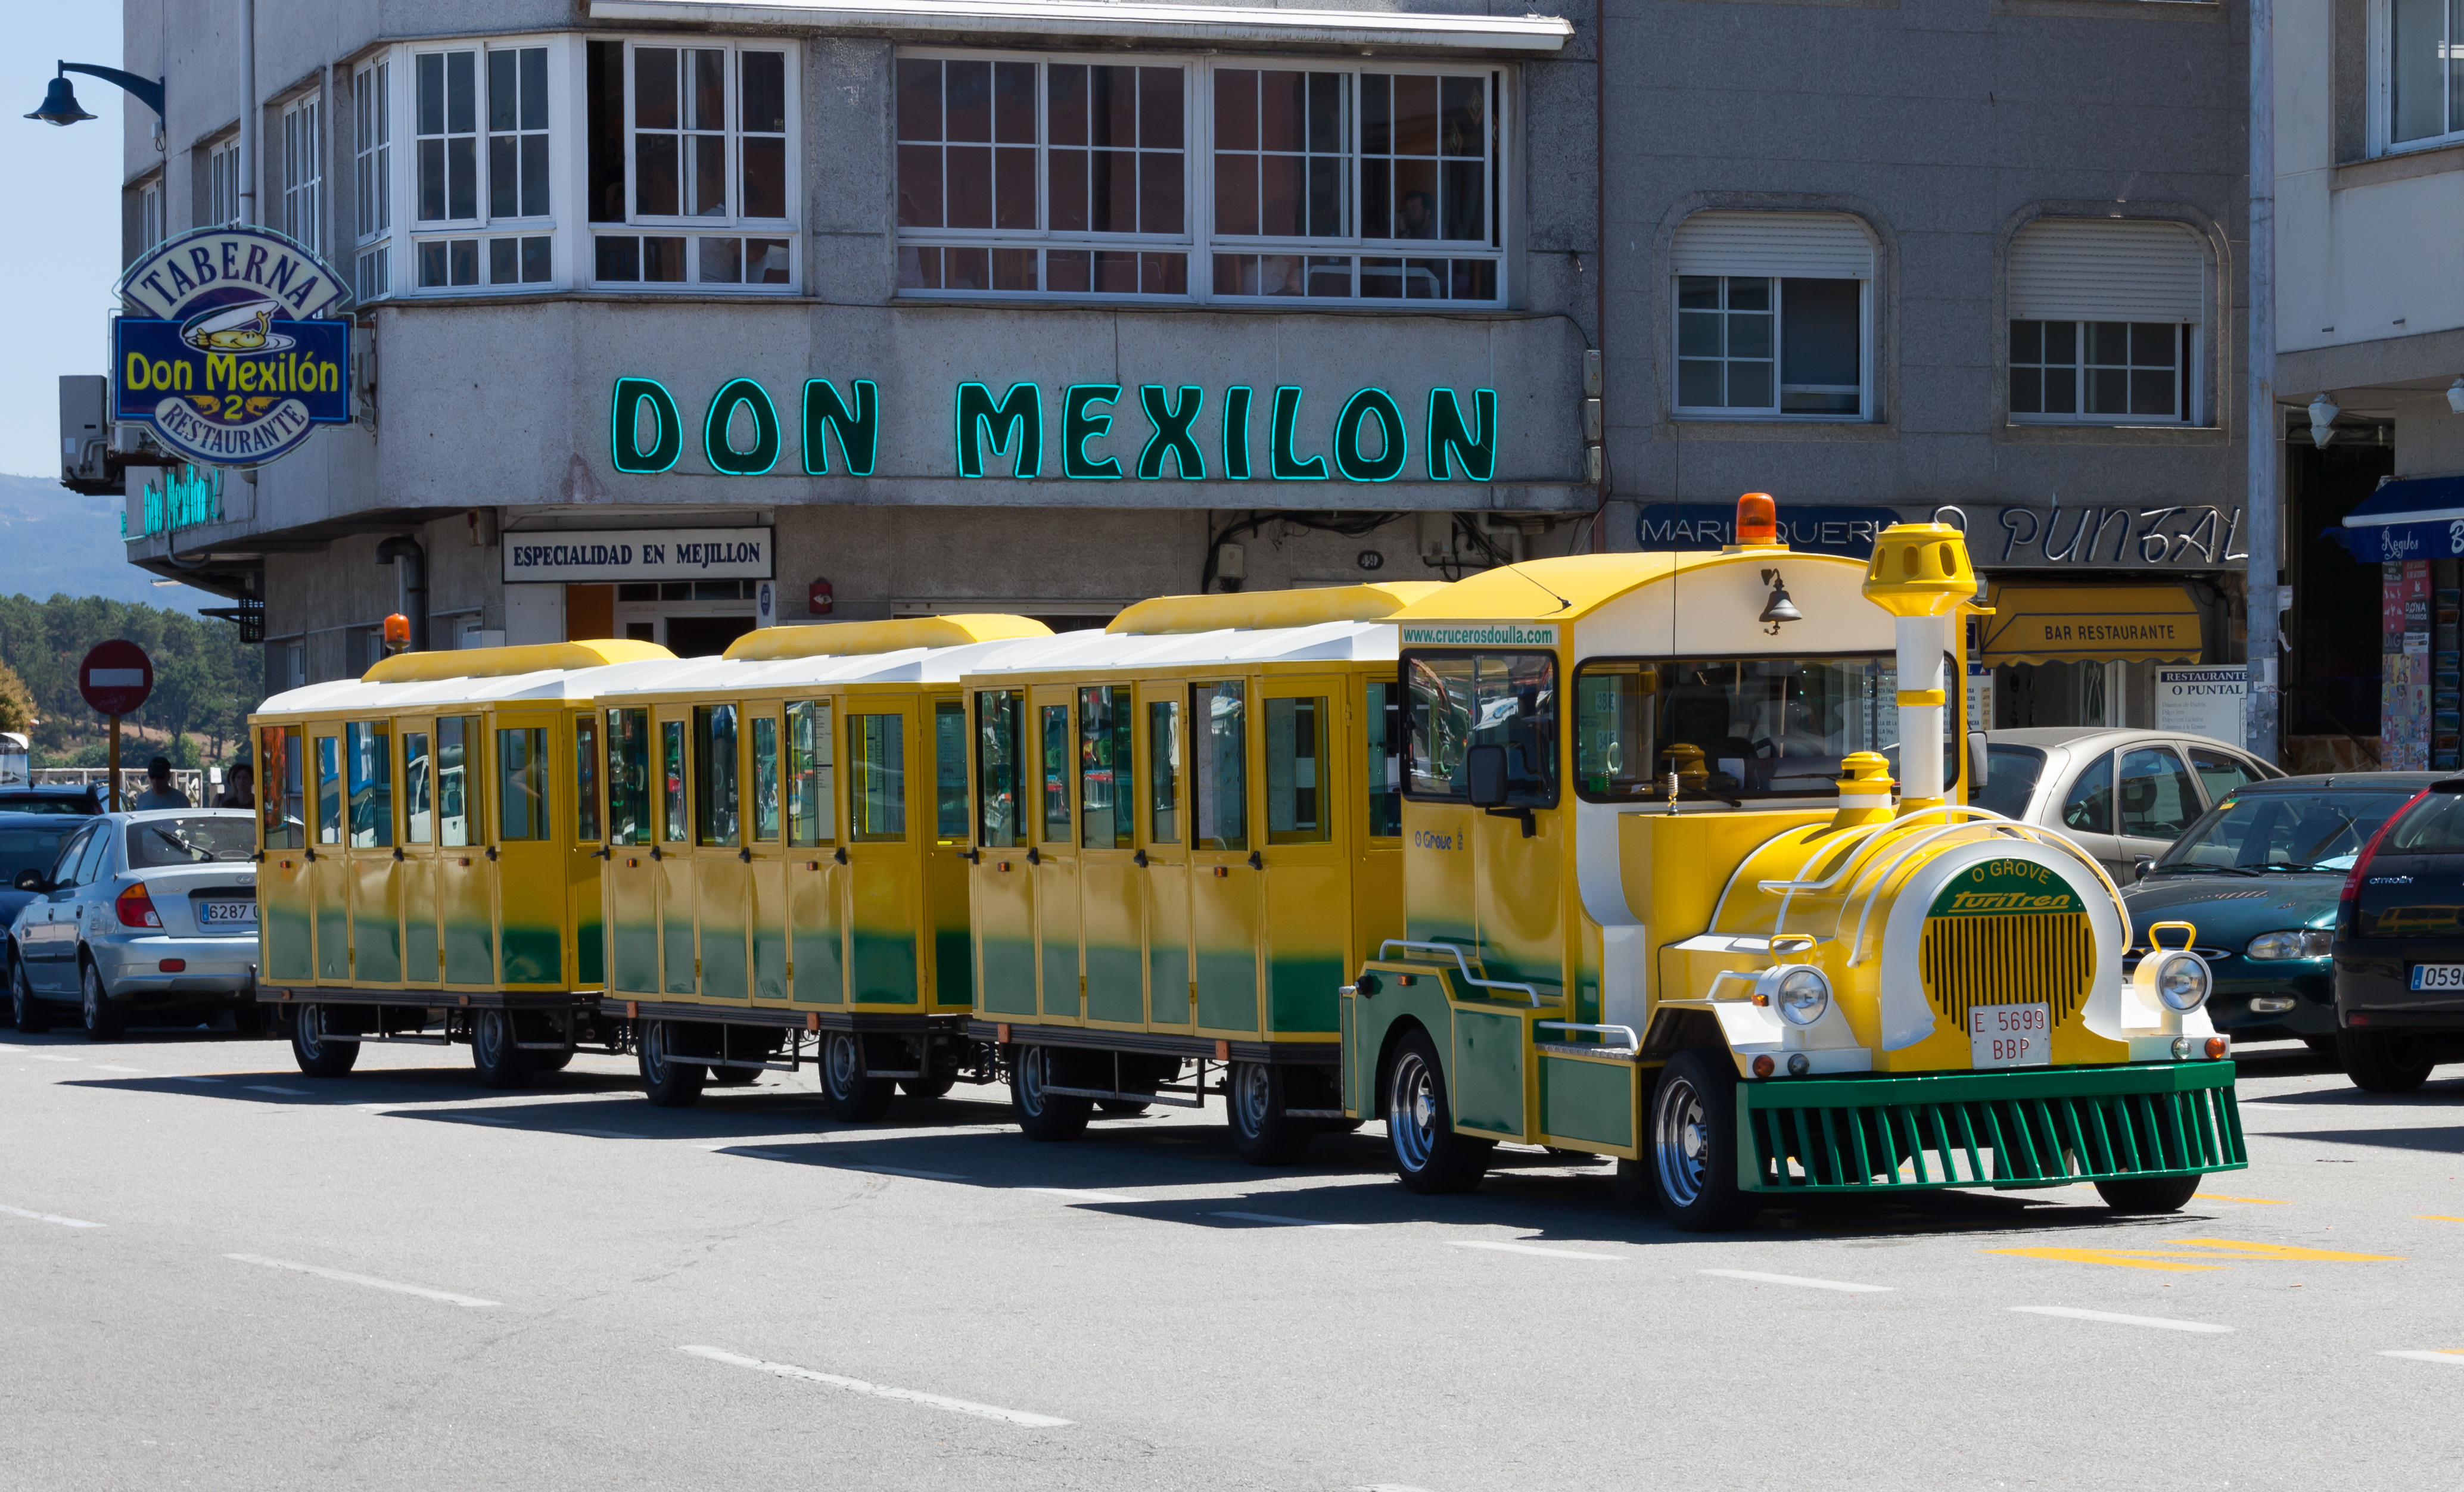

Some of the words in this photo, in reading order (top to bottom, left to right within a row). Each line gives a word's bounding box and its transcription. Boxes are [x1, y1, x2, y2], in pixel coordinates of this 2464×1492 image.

[141, 242, 319, 310] TABERNA
[127, 353, 192, 390] Don
[206, 351, 338, 391] Mexilón
[224, 395, 242, 419] 2
[161, 403, 306, 454] RESTAURANTE
[612, 376, 879, 477] DON
[956, 381, 1498, 482] MEXILON
[514, 544, 633, 567] ESPECIALIDAD
[642, 544, 665, 565] EN
[676, 542, 761, 569] MEJILLON
[1404, 625, 1553, 643] www.crucerosdoulla.com
[2045, 625, 2072, 640] BAR
[2078, 625, 2176, 640] RESTAURANTE
[2166, 672, 2247, 681] RESTAURANTE
[2172, 686, 2183, 696] O
[2187, 684, 2244, 695] PUNTAL
[1972, 867, 1985, 883] O
[1990, 861, 2051, 885] GROVE
[2369, 876, 2413, 884] CITROËN
[209, 905, 247, 919] 6287
[2425, 967, 2464, 986] 059
[1974, 1013, 1985, 1033] E
[1998, 1009, 2045, 1031] 5699
[1993, 1038, 2030, 1060] BBP
